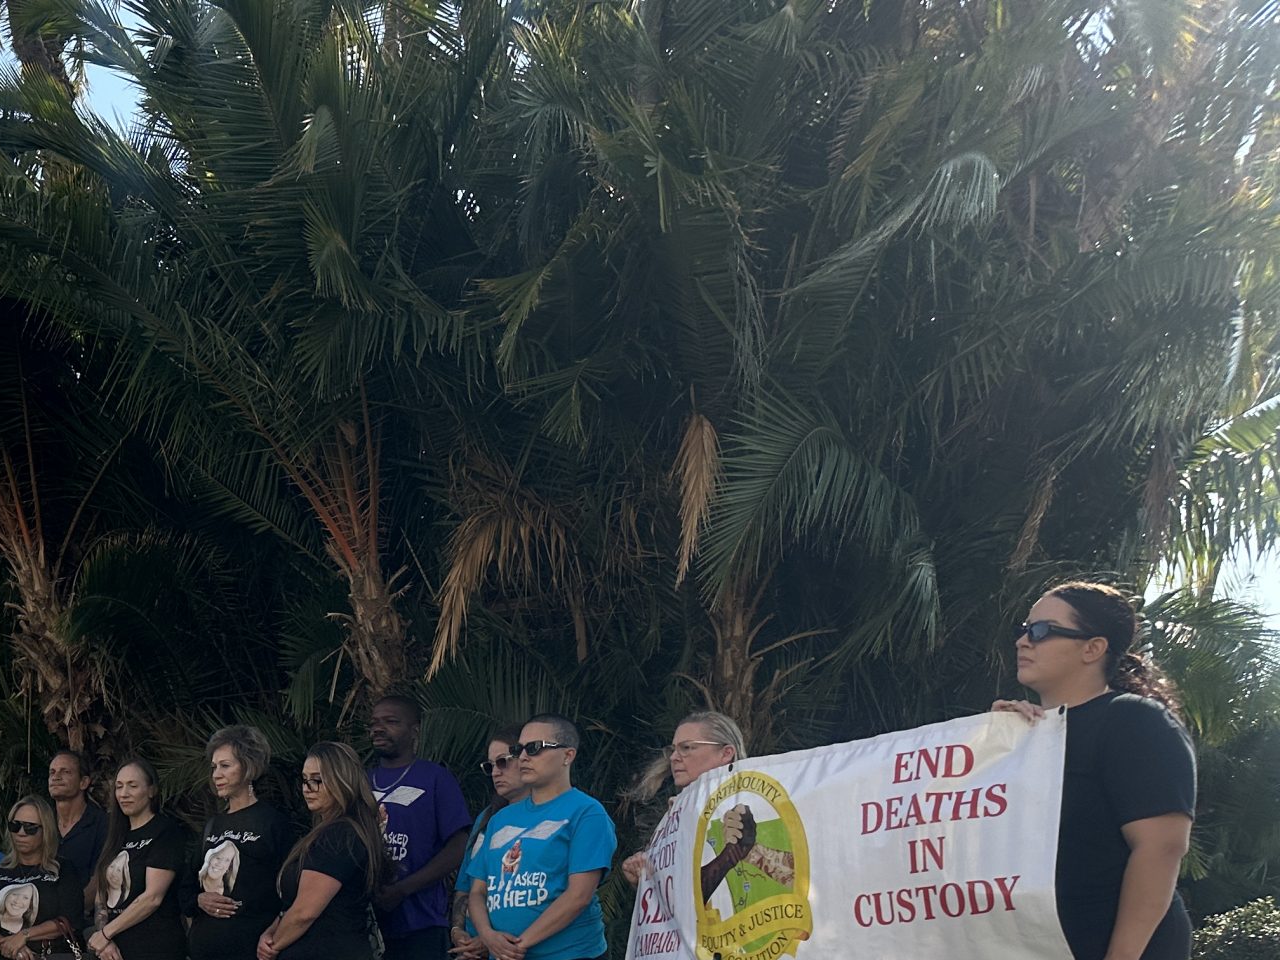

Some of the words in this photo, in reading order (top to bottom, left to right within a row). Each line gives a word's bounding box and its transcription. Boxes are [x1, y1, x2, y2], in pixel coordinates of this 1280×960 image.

[892, 744, 974, 784] END
[703, 779, 737, 820] NORTH
[737, 775, 781, 802] COUNTY
[861, 783, 1008, 835] DEATHS
[907, 836, 945, 874] IN
[487, 875, 496, 891] I
[514, 870, 547, 888] ASKED
[503, 887, 548, 908] HELP
[854, 875, 1020, 927] CUSTODY
[634, 929, 681, 958] CAMPAIGN
[701, 929, 737, 953] EQUITY
[739, 923, 747, 937] &
[748, 903, 804, 931] JUSTICE
